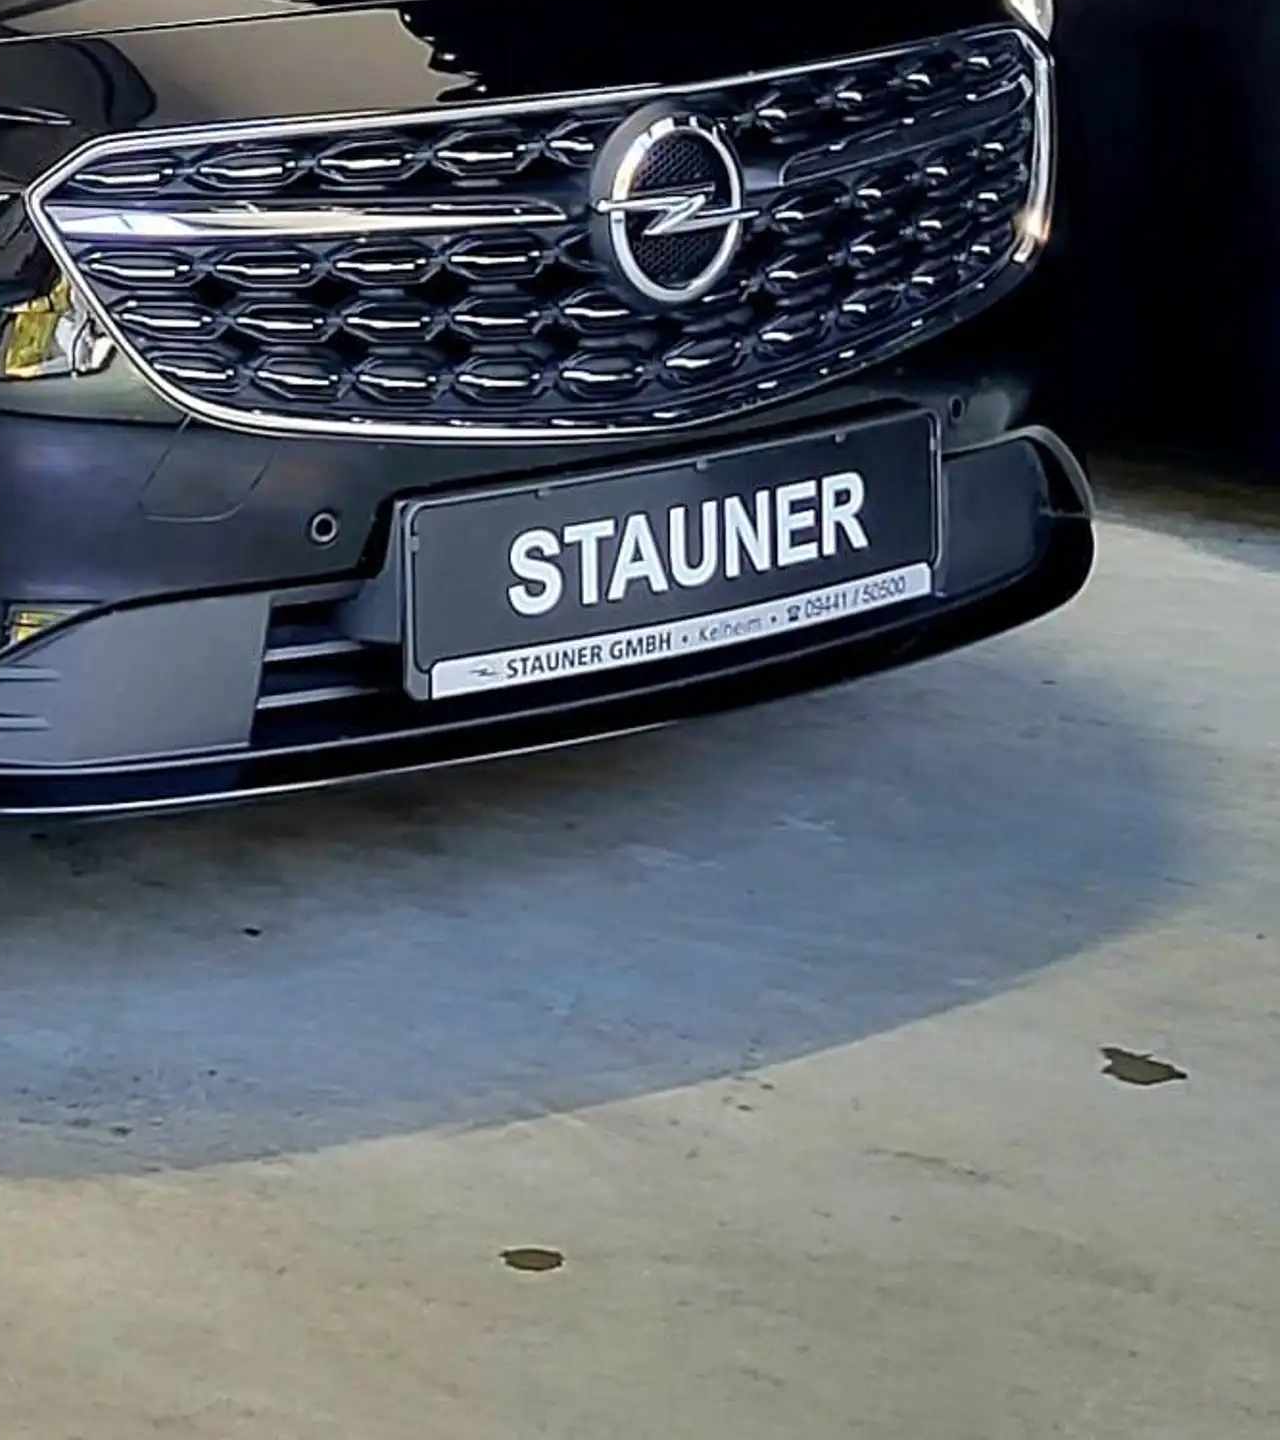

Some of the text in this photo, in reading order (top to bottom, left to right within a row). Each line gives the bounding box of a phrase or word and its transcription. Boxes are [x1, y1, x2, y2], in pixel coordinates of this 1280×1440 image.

[507, 471, 870, 617] STAUNER
[506, 643, 603, 678] STAUNER
[609, 631, 672, 660] GMBH
[804, 591, 848, 619] 09441
[862, 575, 906, 603] 50500
